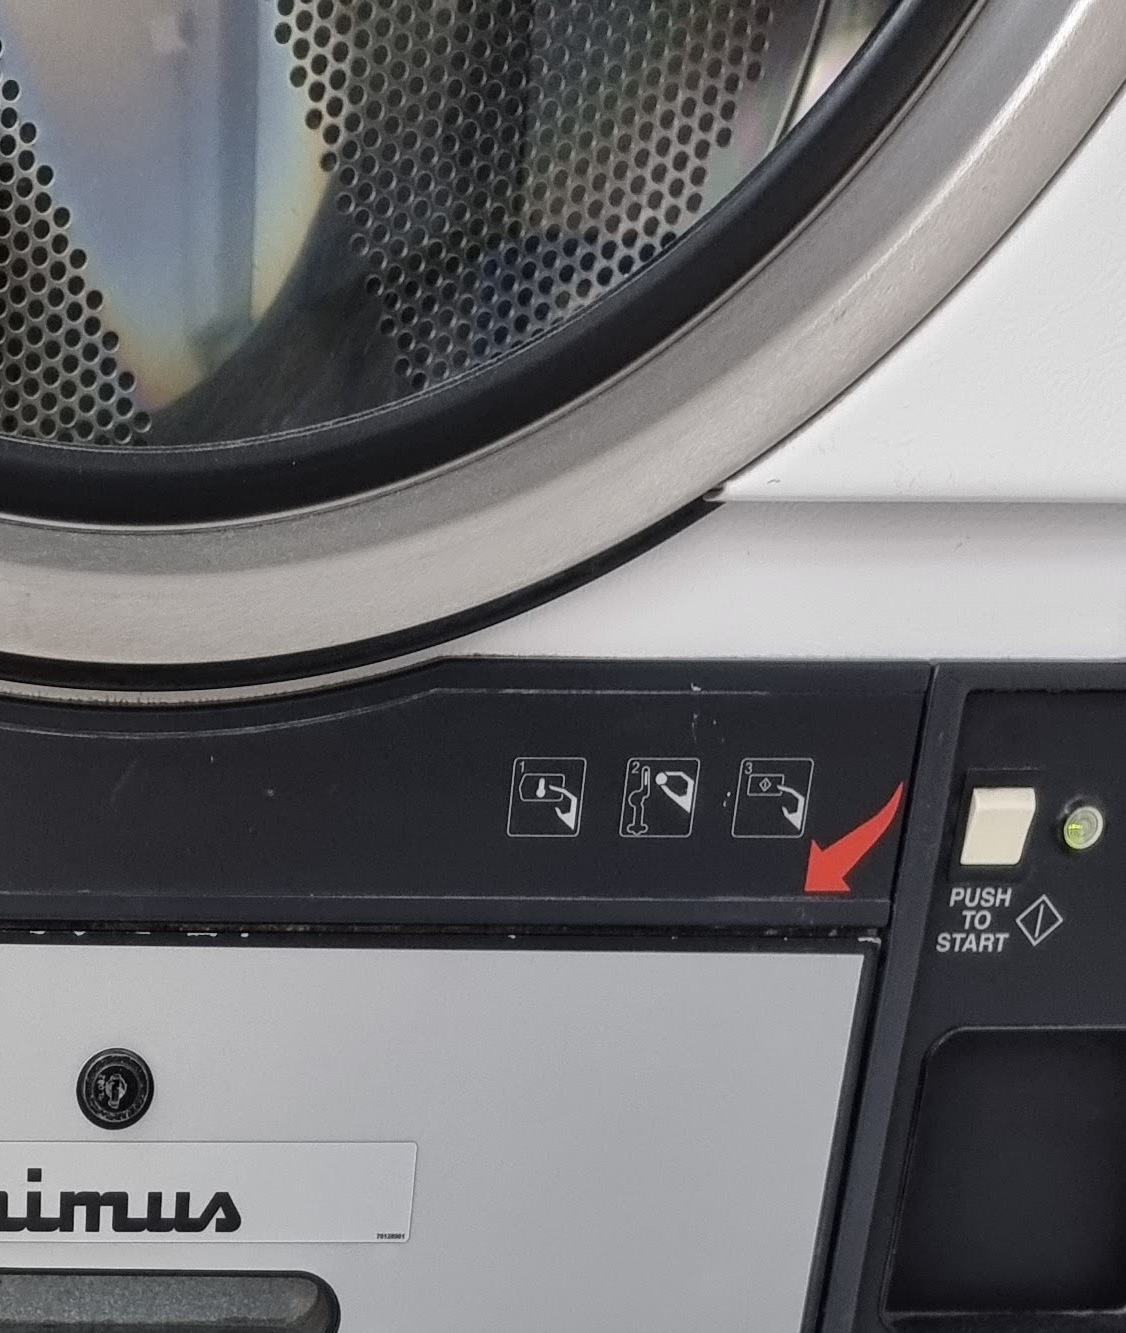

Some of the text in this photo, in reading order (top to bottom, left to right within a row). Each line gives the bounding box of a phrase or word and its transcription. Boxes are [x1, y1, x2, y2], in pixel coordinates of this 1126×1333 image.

[519, 760, 526, 774] 1
[631, 761, 641, 774] 2
[743, 761, 753, 775] 3
[949, 887, 1013, 908] PUSH
[962, 909, 993, 930] TO
[935, 932, 1010, 954] START
